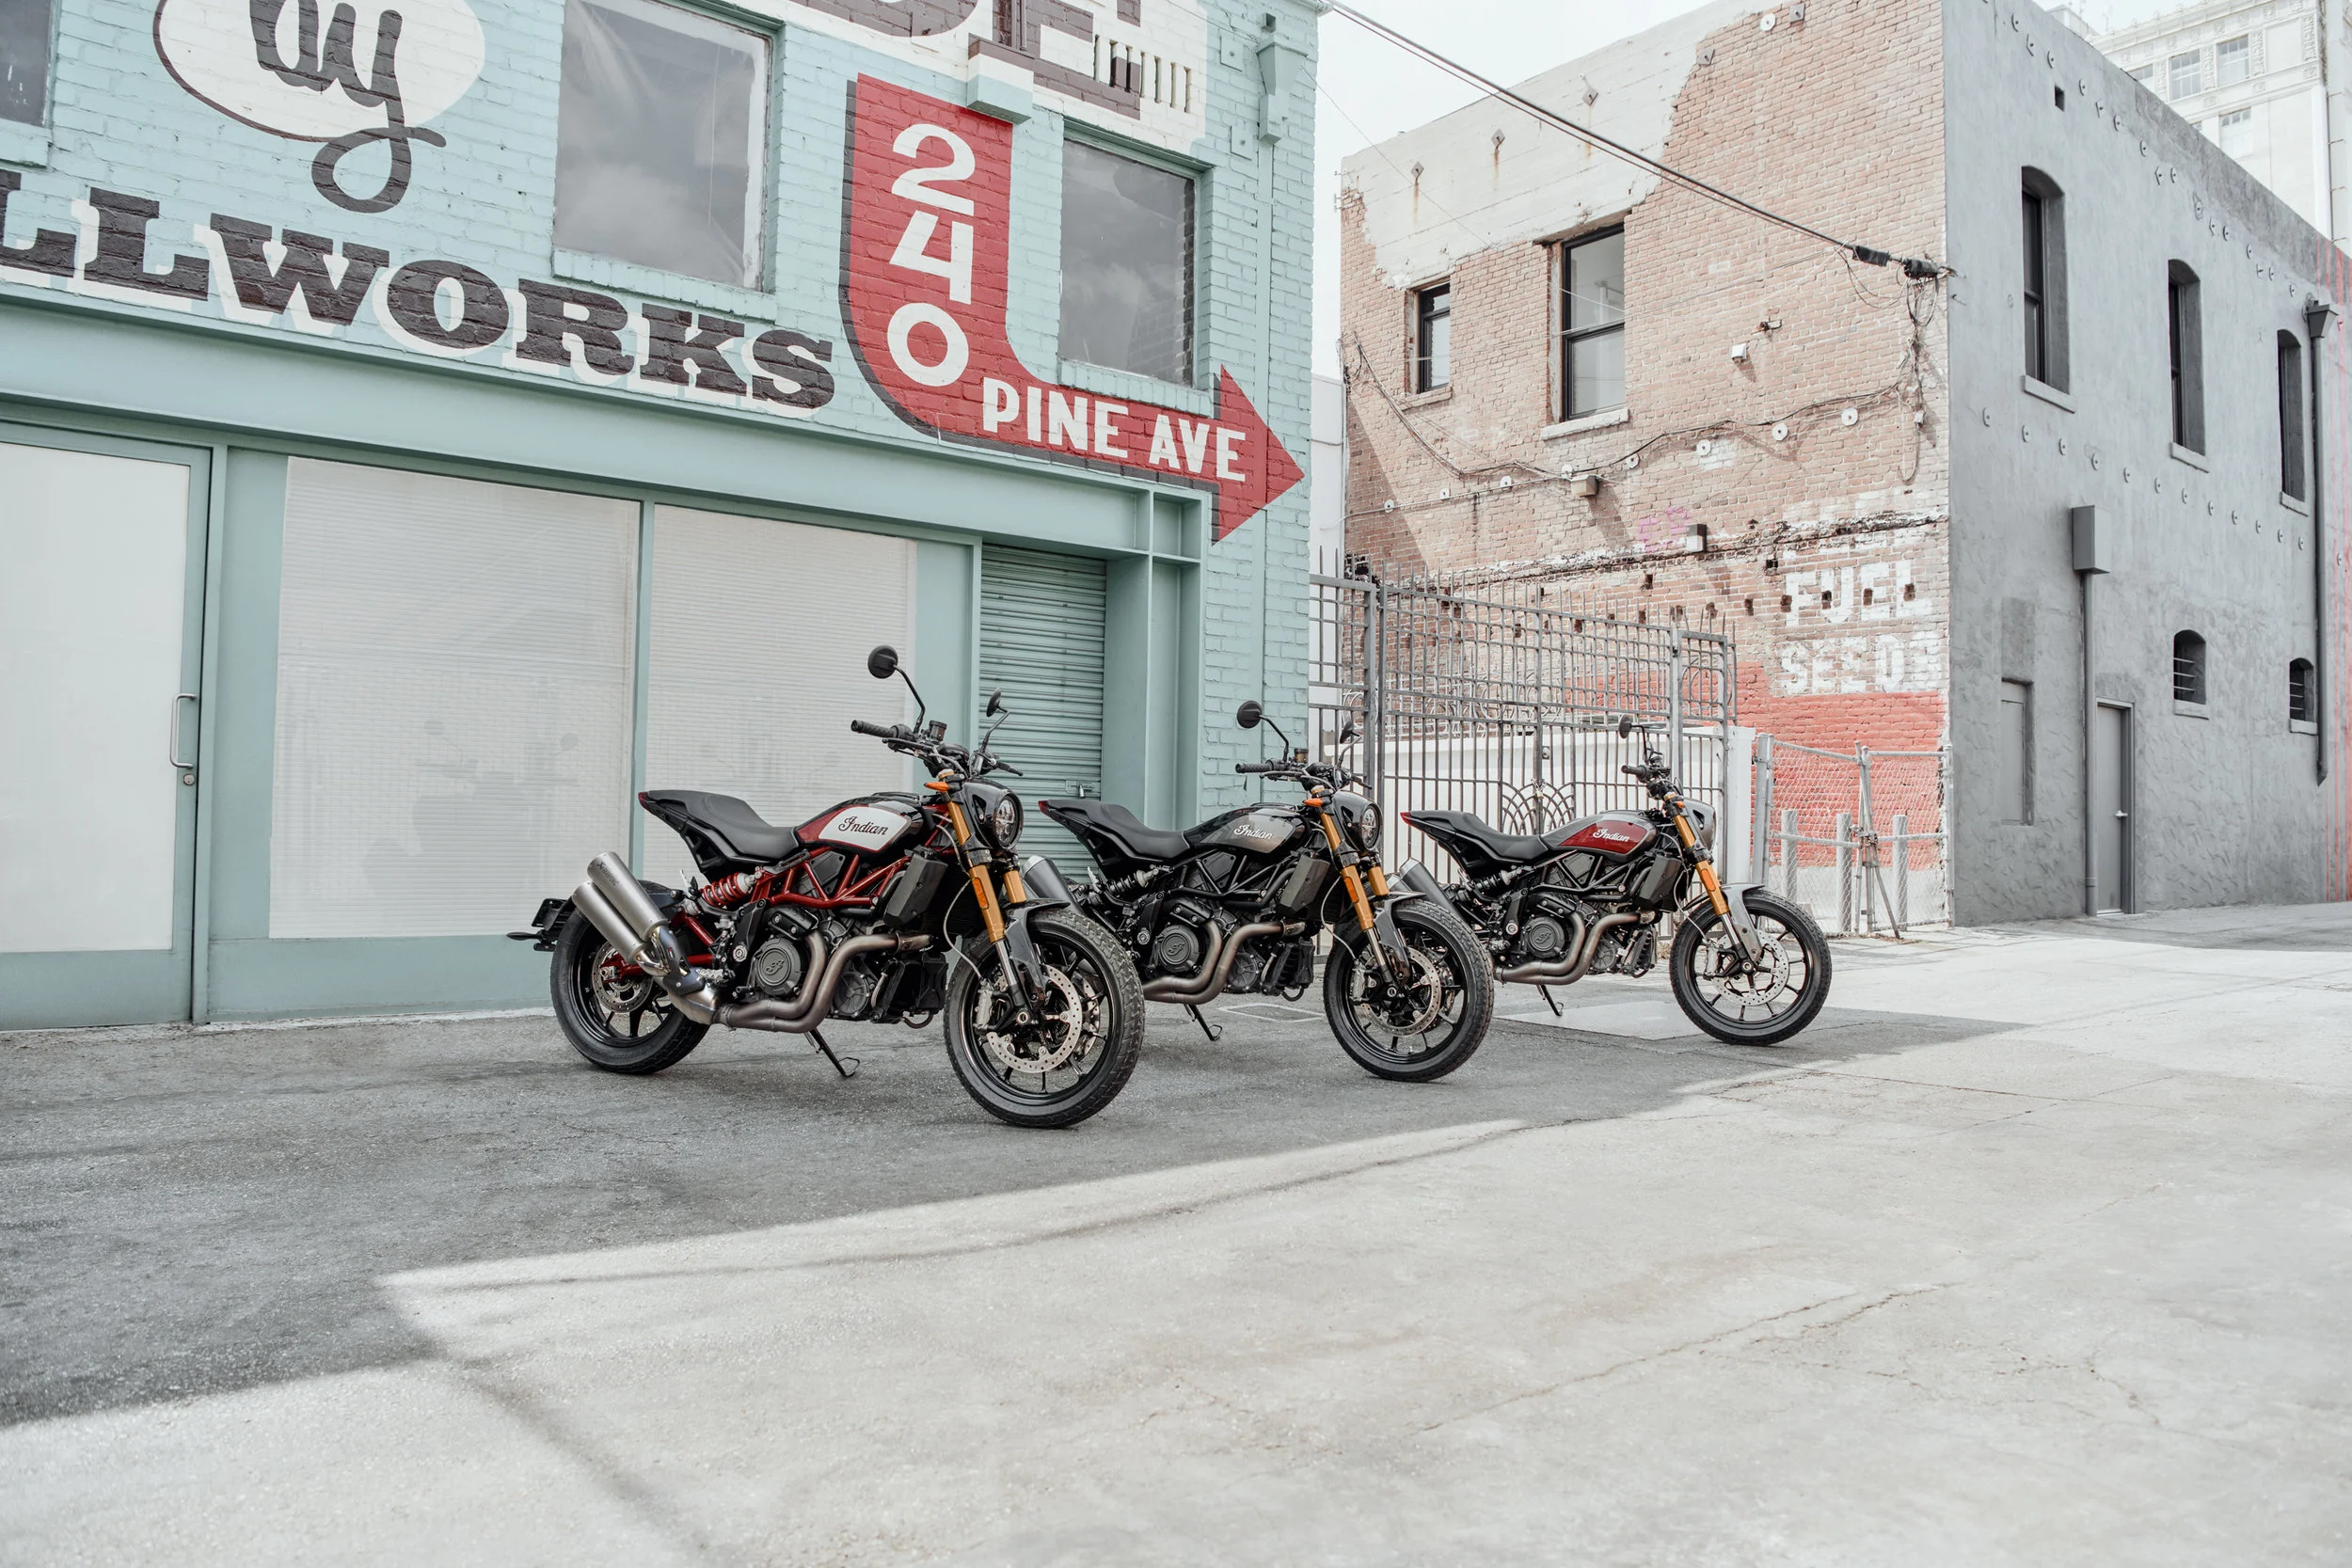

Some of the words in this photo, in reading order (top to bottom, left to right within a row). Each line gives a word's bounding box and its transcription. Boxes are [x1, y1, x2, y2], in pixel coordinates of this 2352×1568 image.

[982, 378, 1129, 459] PINE
[1149, 415, 1246, 483] AVE
[1786, 561, 1932, 627] FUEL
[838, 816, 889, 835] Indian
[1233, 824, 1273, 840] Indian
[1592, 828, 1630, 843] Indian
